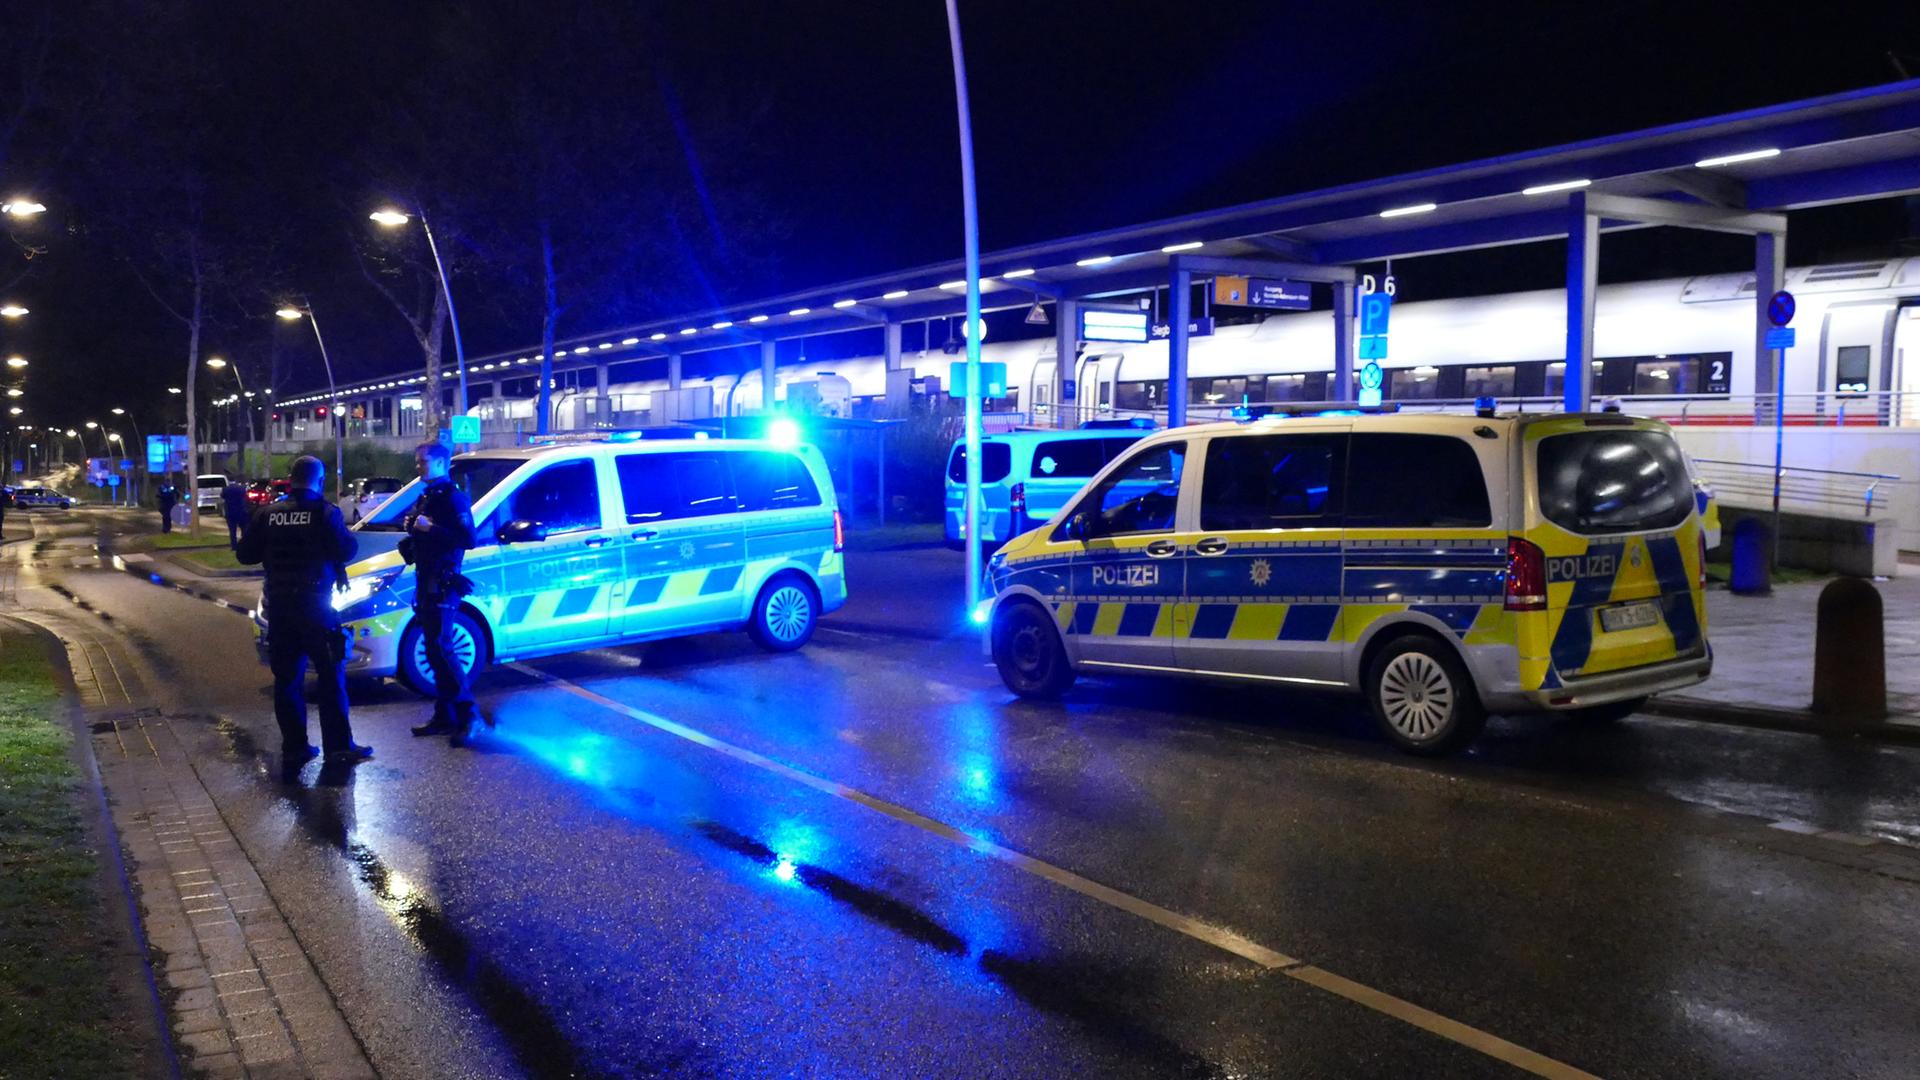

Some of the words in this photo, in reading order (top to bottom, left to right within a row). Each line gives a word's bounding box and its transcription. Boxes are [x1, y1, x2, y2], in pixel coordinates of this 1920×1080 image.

[1363, 274, 1376, 295] D
[1384, 273, 1396, 296] 6
[1366, 300, 1382, 331] P
[1711, 360, 1724, 380] 2
[1148, 385, 1156, 398] 2
[269, 511, 312, 526] POLIZEI
[528, 557, 600, 579] POLIZEI
[1092, 565, 1158, 585] POLIZEI
[1548, 555, 1616, 580] POLIZEI
